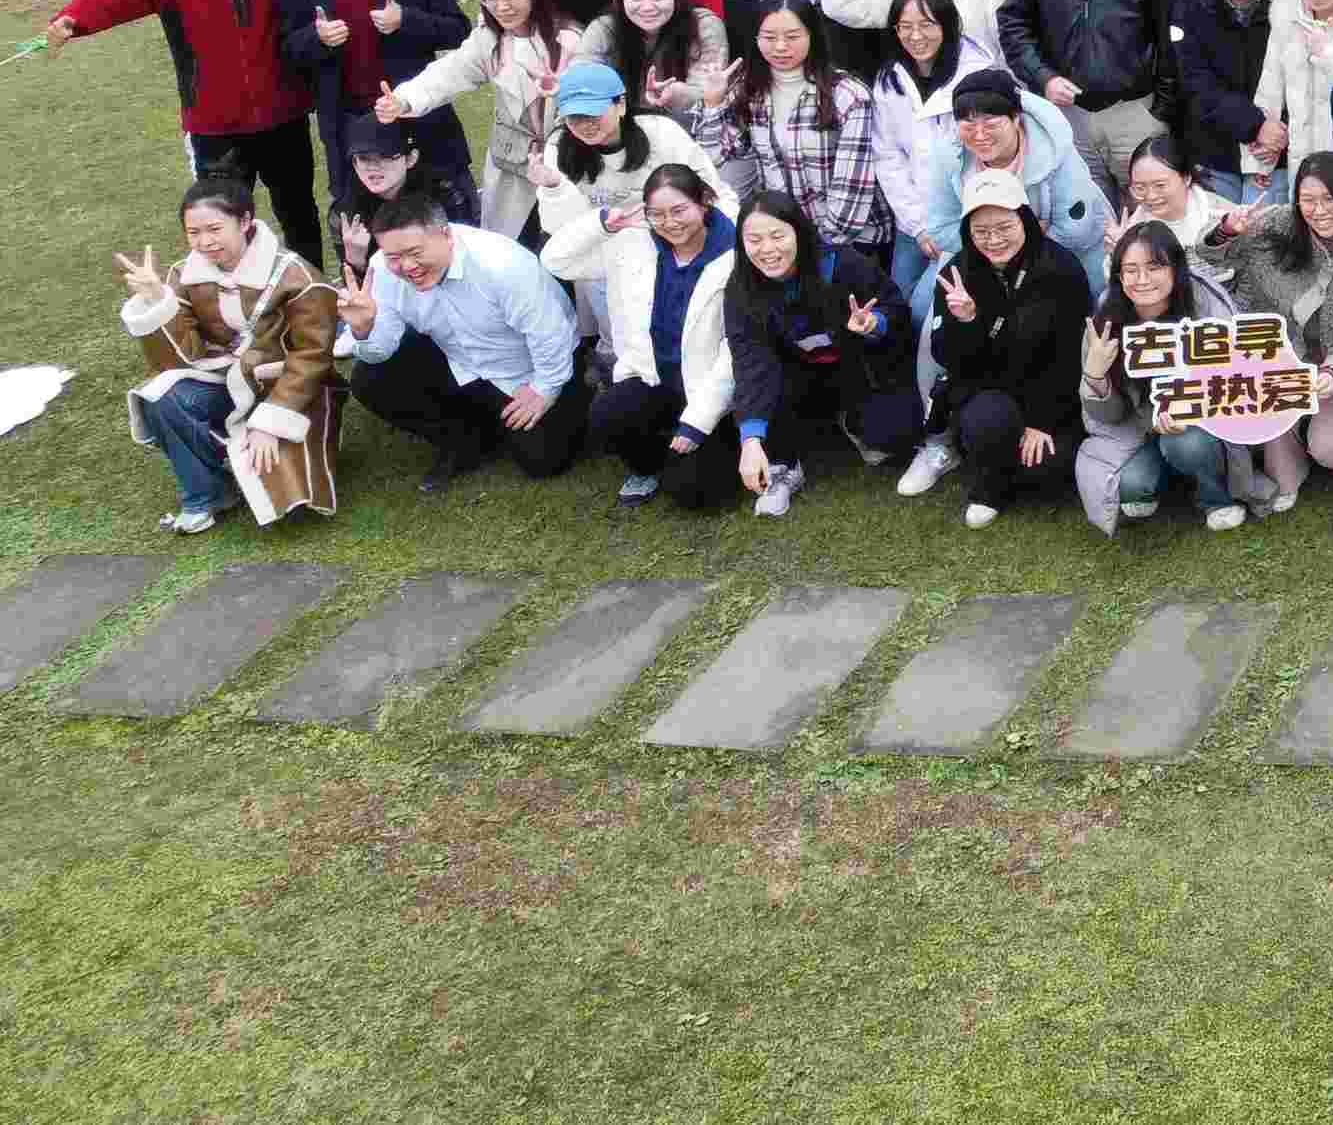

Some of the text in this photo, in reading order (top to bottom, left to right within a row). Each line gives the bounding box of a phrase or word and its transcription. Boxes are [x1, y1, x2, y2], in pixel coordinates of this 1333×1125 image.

[1126, 319, 1285, 371] 去追寻
[1156, 368, 1314, 420] 去热爱
